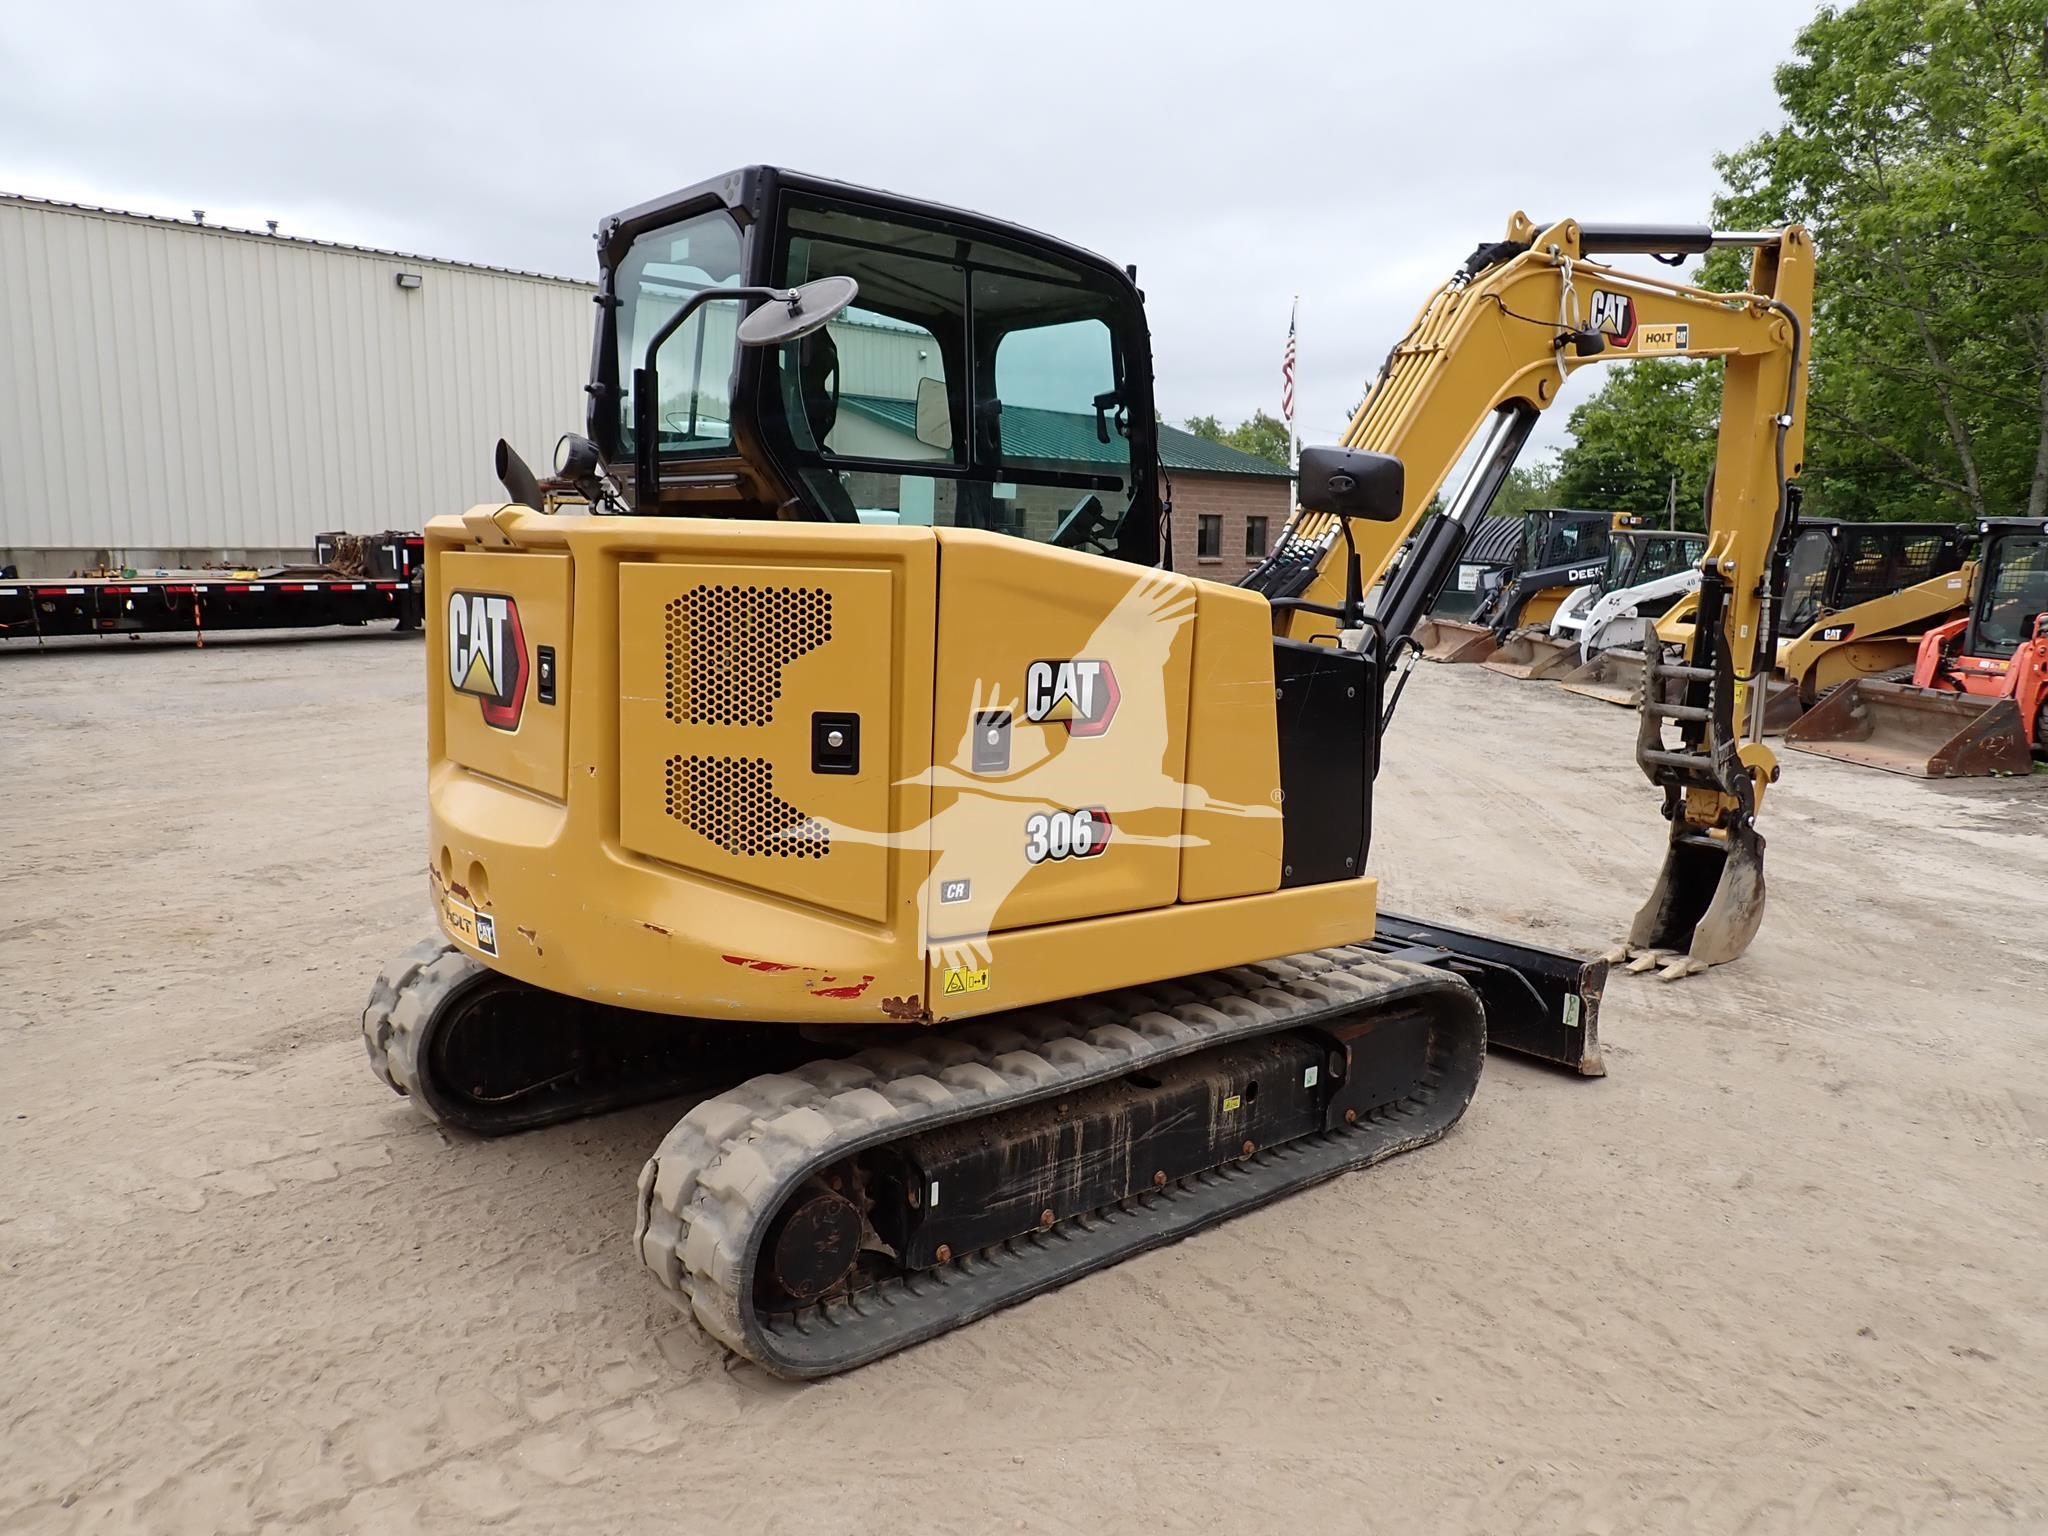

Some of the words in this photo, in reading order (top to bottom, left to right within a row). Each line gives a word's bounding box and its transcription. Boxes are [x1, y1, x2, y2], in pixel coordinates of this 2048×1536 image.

[1591, 290, 1628, 335] CAT
[1646, 333, 1673, 343] HOLT
[449, 593, 507, 697] CAT
[1824, 629, 1842, 641] CAT
[1027, 662, 1100, 721] CAT
[1027, 810, 1093, 861] 306
[946, 883, 965, 899] CR
[477, 921, 493, 945] CAT
